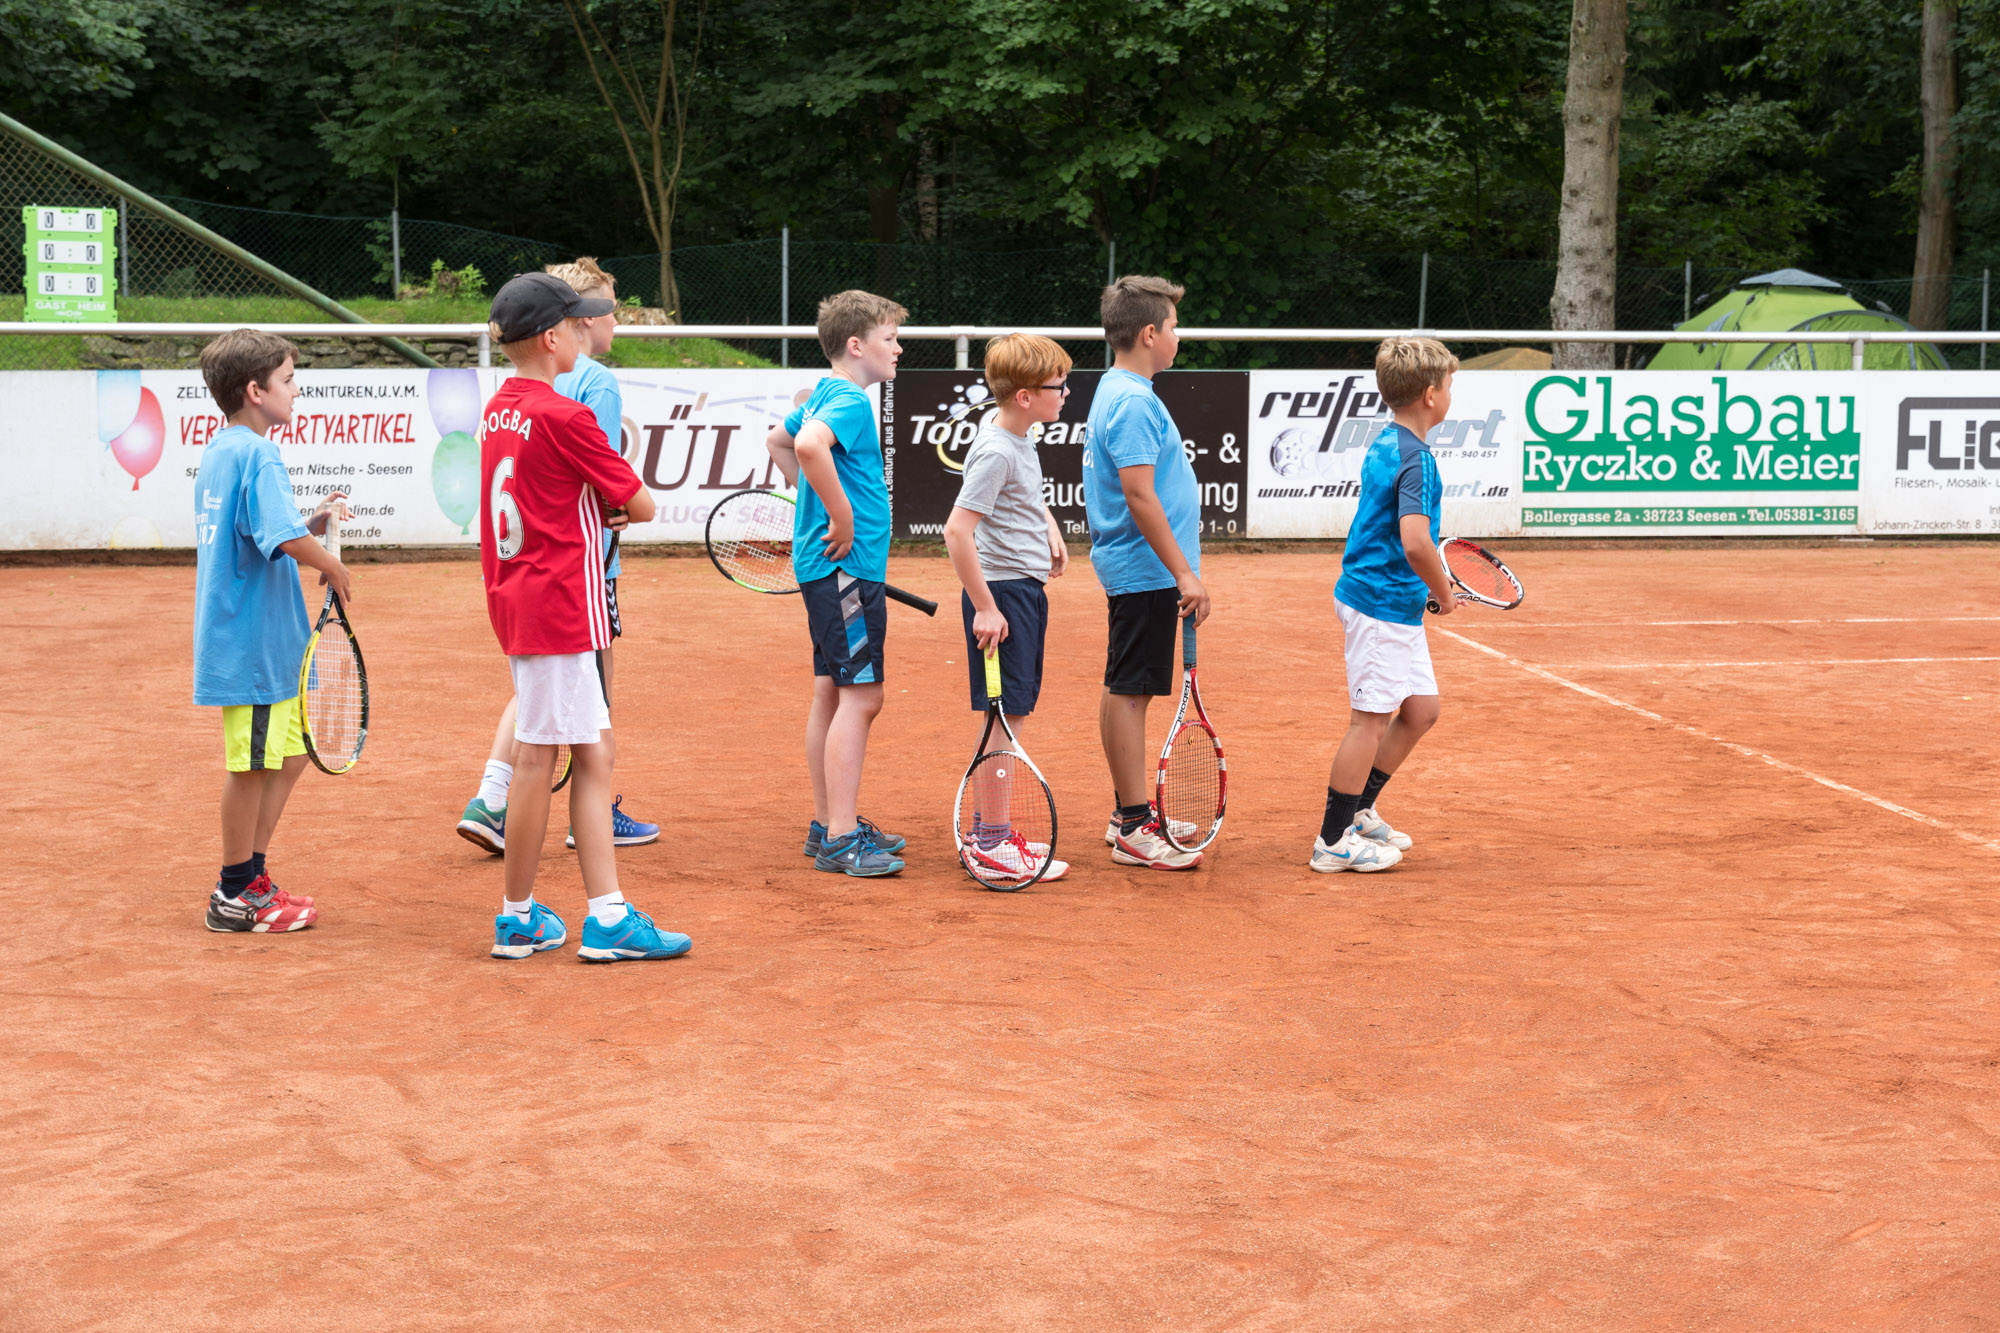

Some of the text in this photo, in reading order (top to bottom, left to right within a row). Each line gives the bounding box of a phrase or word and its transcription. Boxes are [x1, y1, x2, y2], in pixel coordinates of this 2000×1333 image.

[35, 301, 106, 311] GAST HEIM
[177, 385, 420, 399] ZELT ARNITUREN,U.V.M.
[883, 378, 894, 424] Erfahrun
[1258, 375, 1388, 453] reife
[1525, 375, 1861, 441] Glasbau
[482, 408, 533, 442] POGBA
[885, 425, 894, 446] aus
[1219, 432, 1242, 464] &
[307, 463, 356, 476] Nitsche
[367, 463, 413, 476] Seesen
[1524, 444, 1860, 491] Ryczko & Meier
[1946, 476, 1992, 489] Mosaik-
[490, 456, 525, 561] 6
[1523, 509, 1612, 526] Bollergasse
[1614, 509, 1633, 523] 2a
[1642, 509, 1684, 523] 38723
[1686, 508, 1738, 522] Seesen
[1063, 520, 1090, 534] Tel.
[1872, 519, 1971, 531] Johann-Zincken-Str.
